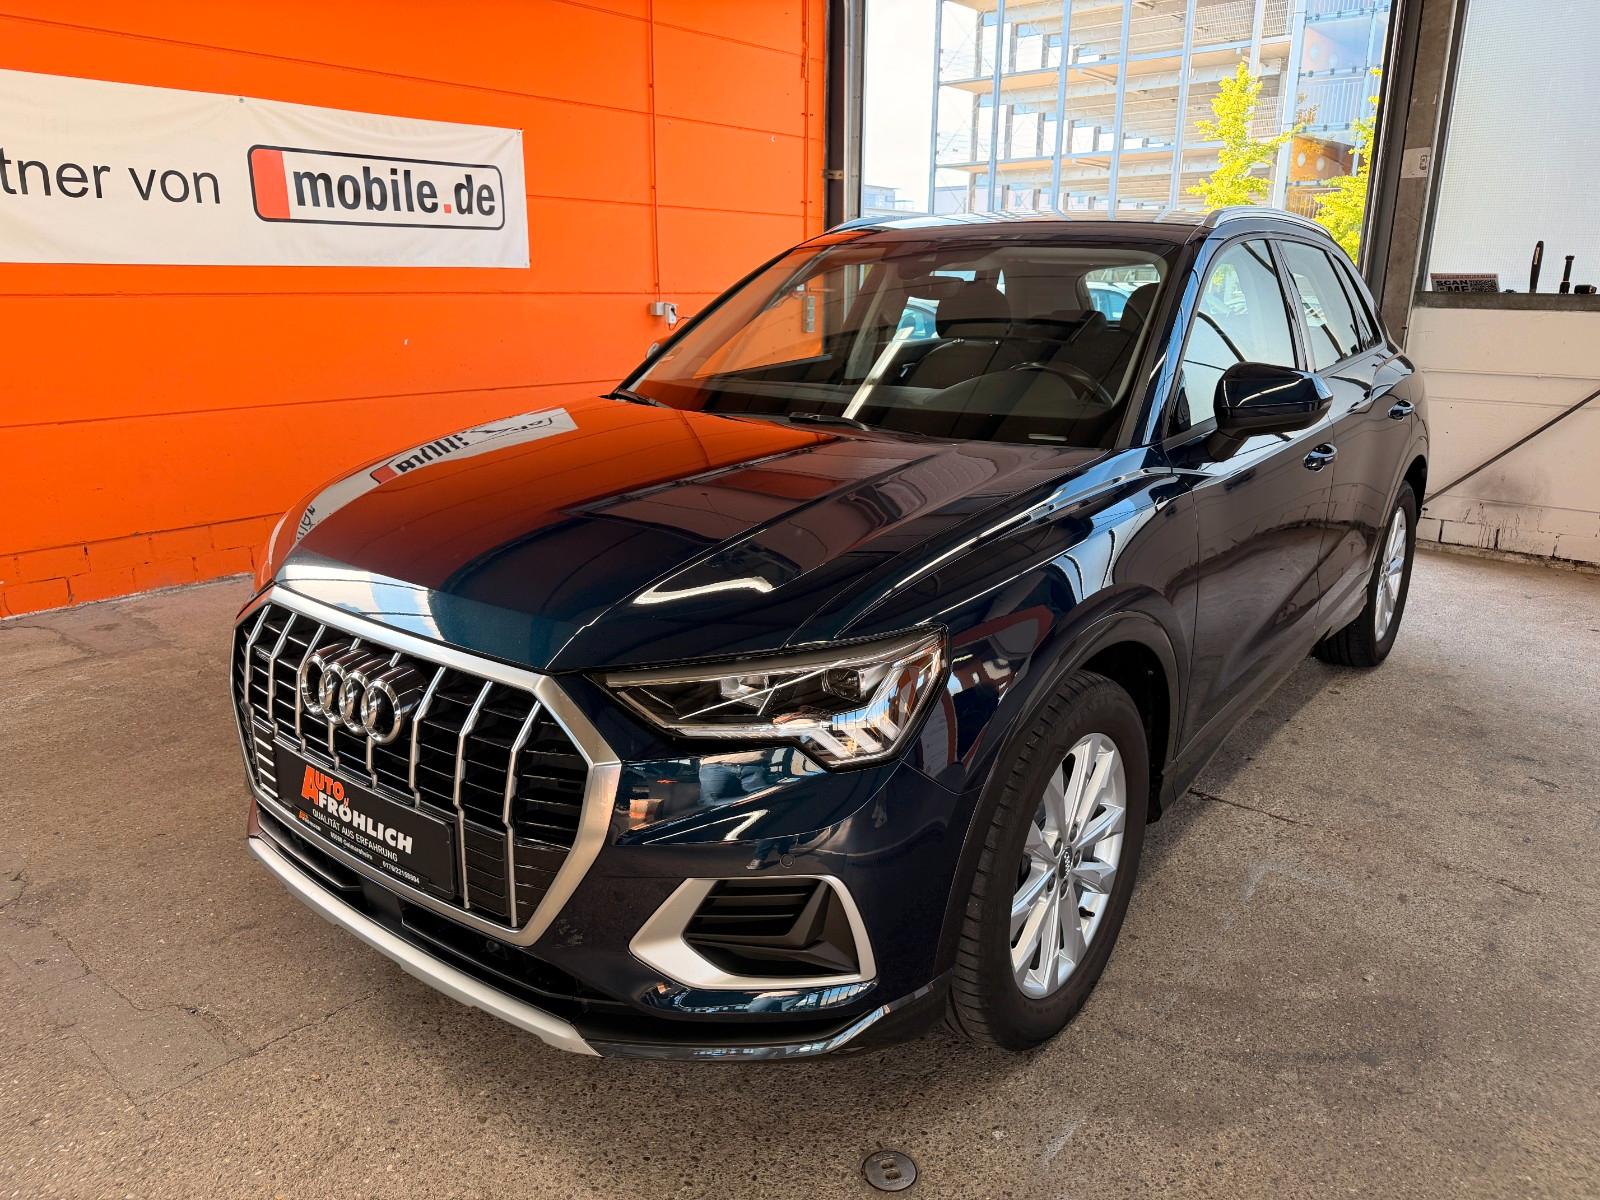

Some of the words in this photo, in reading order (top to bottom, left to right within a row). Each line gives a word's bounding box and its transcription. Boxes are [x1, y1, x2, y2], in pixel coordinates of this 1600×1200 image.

[0, 147, 110, 199] tner
[128, 168, 220, 204] von
[291, 166, 496, 216] mobile.de
[301, 765, 344, 805] AUTO
[312, 808, 341, 832] QUALITÄT
[341, 826, 355, 840] AUS
[355, 833, 398, 862] ERFAHRUNG
[318, 791, 413, 855] FRÖHLICH
